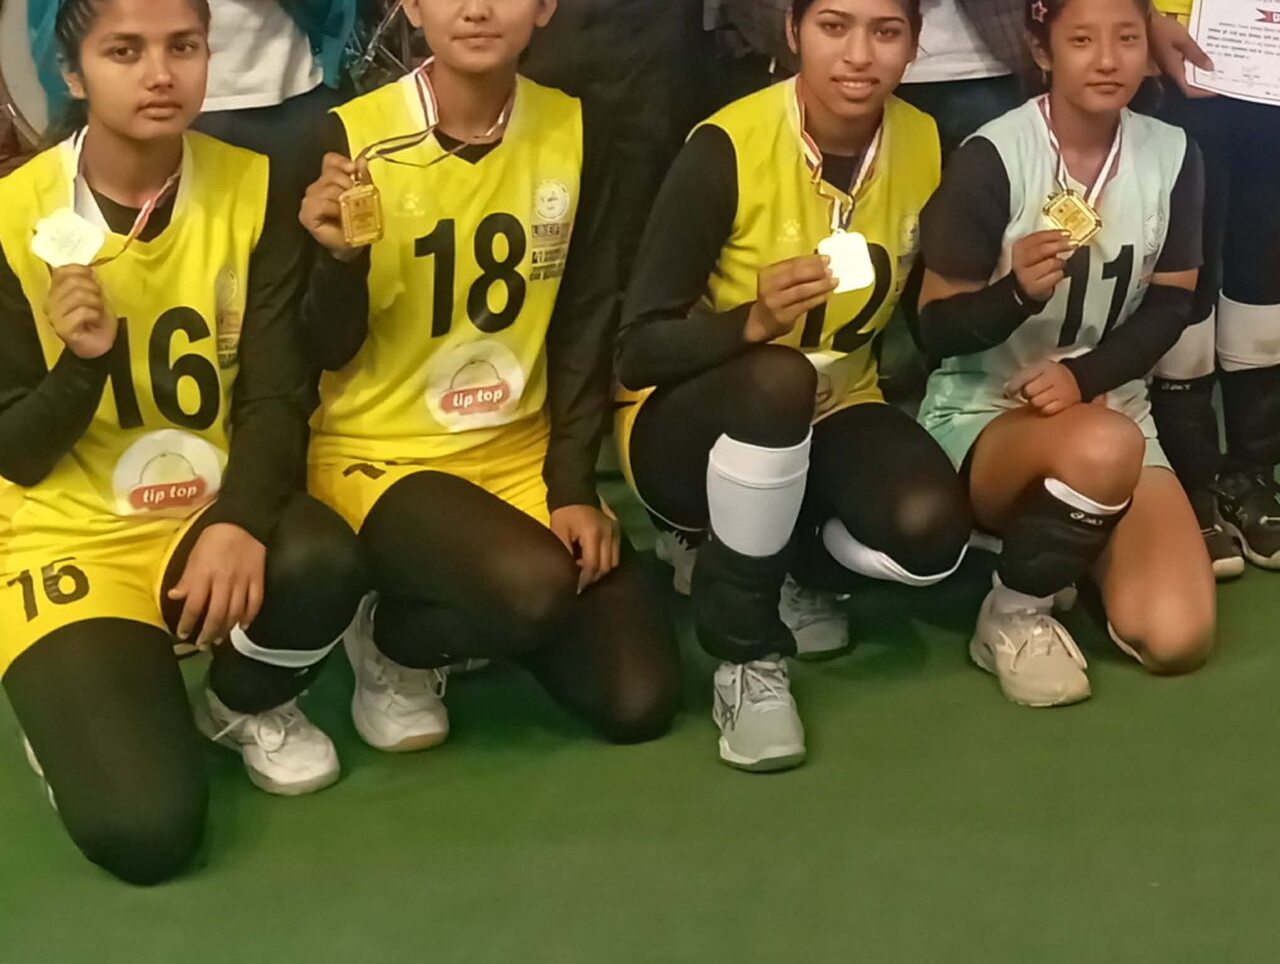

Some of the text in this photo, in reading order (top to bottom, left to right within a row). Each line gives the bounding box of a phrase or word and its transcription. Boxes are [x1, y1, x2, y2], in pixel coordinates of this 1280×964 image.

[414, 211, 527, 338] 18
[1057, 244, 1135, 347] 11
[108, 306, 221, 430] 16
[453, 388, 503, 409] tip top
[142, 483, 198, 504] tip top
